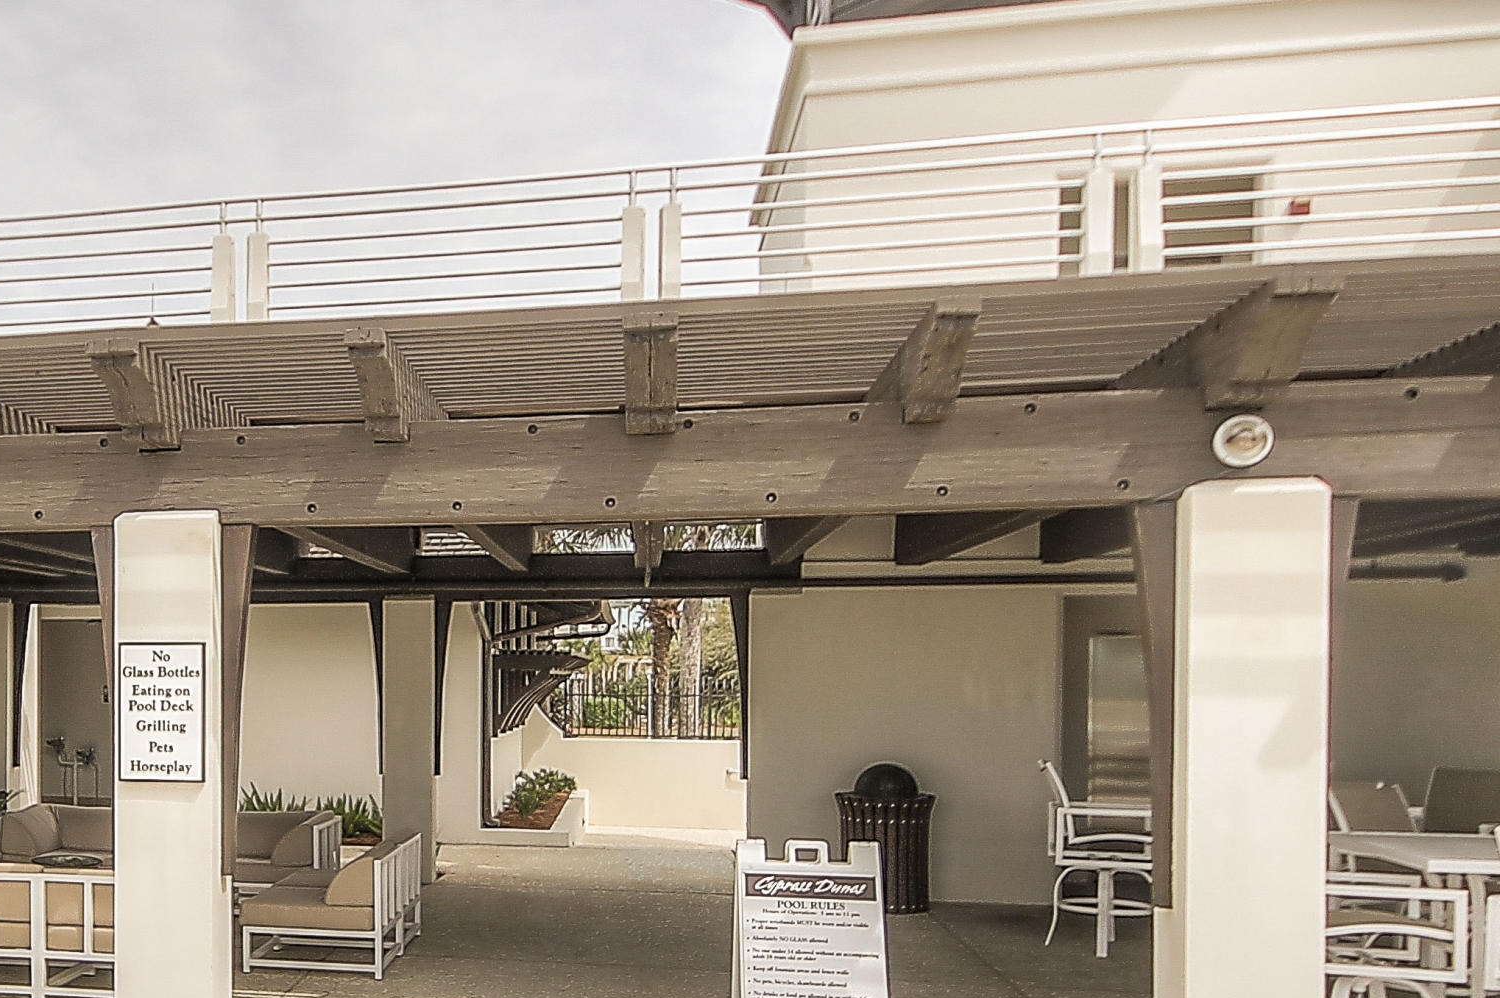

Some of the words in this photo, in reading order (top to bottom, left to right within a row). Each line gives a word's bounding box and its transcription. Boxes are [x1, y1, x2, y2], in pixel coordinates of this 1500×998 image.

[152, 650, 171, 662] No
[122, 666, 154, 678] Glass
[158, 666, 200, 678] Bottles
[132, 685, 172, 698] Eating
[175, 688, 190, 696] on
[128, 700, 156, 711] Pool
[160, 700, 194, 712] Deck
[136, 720, 186, 734] Grilling
[149, 742, 174, 752] Pets
[130, 760, 192, 774] Horseplay
[754, 875, 812, 895] Cypress
[813, 879, 867, 895] Dunes
[777, 900, 807, 909] POOL
[810, 901, 845, 910] RULES
